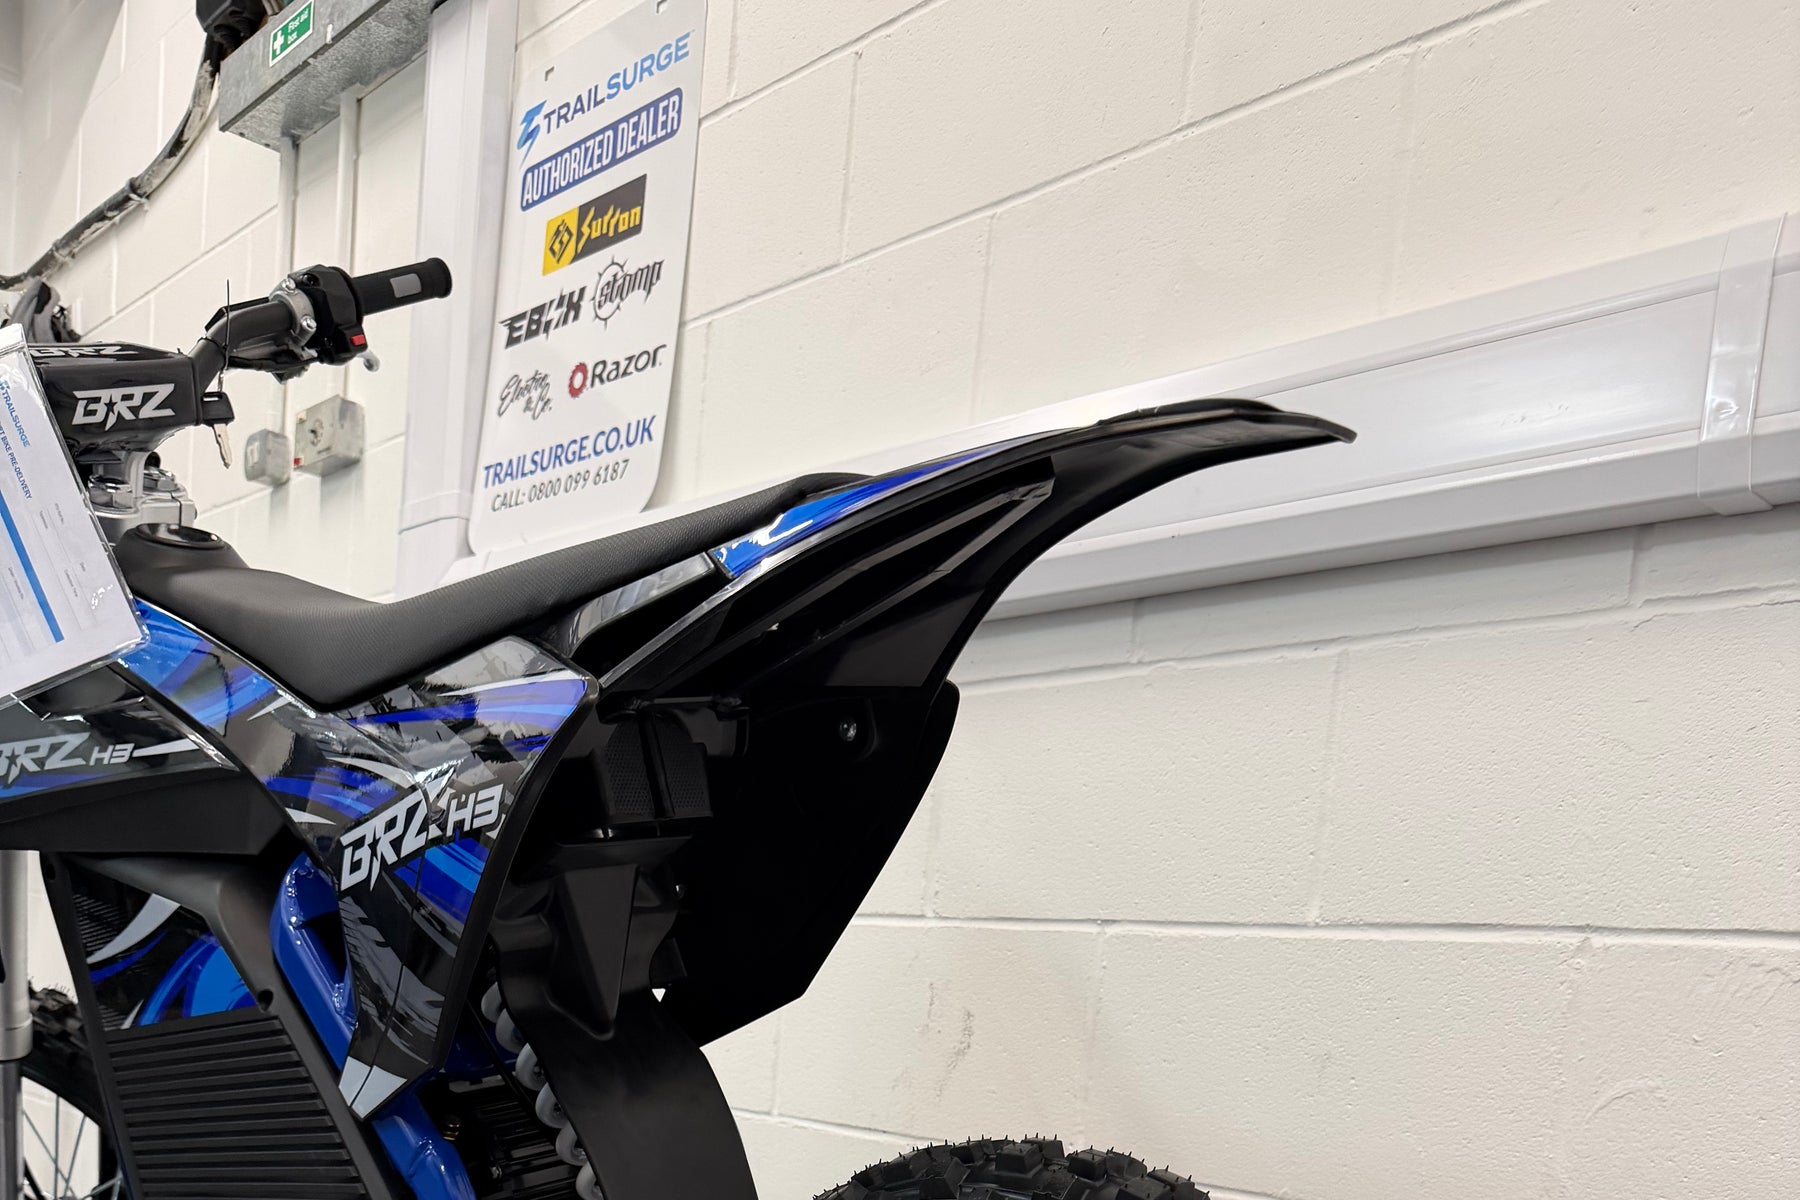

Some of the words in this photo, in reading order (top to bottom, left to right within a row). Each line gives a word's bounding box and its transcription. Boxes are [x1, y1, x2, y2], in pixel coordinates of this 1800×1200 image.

[543, 31, 690, 134] TRAILSURGE
[522, 130, 614, 207] AUTHORIZED
[616, 94, 680, 160] DEALER
[590, 344, 667, 388] Razor
[2, 389, 31, 448] TRAILSURGE
[72, 384, 176, 431] BRZ
[484, 415, 656, 489] TRAILSURGE.CO.UK
[491, 488, 525, 513] CALL:
[528, 478, 561, 504] 0800
[564, 470, 590, 494] 099
[594, 459, 630, 487] 6187
[89, 743, 135, 766] H3
[446, 784, 504, 838] H3
